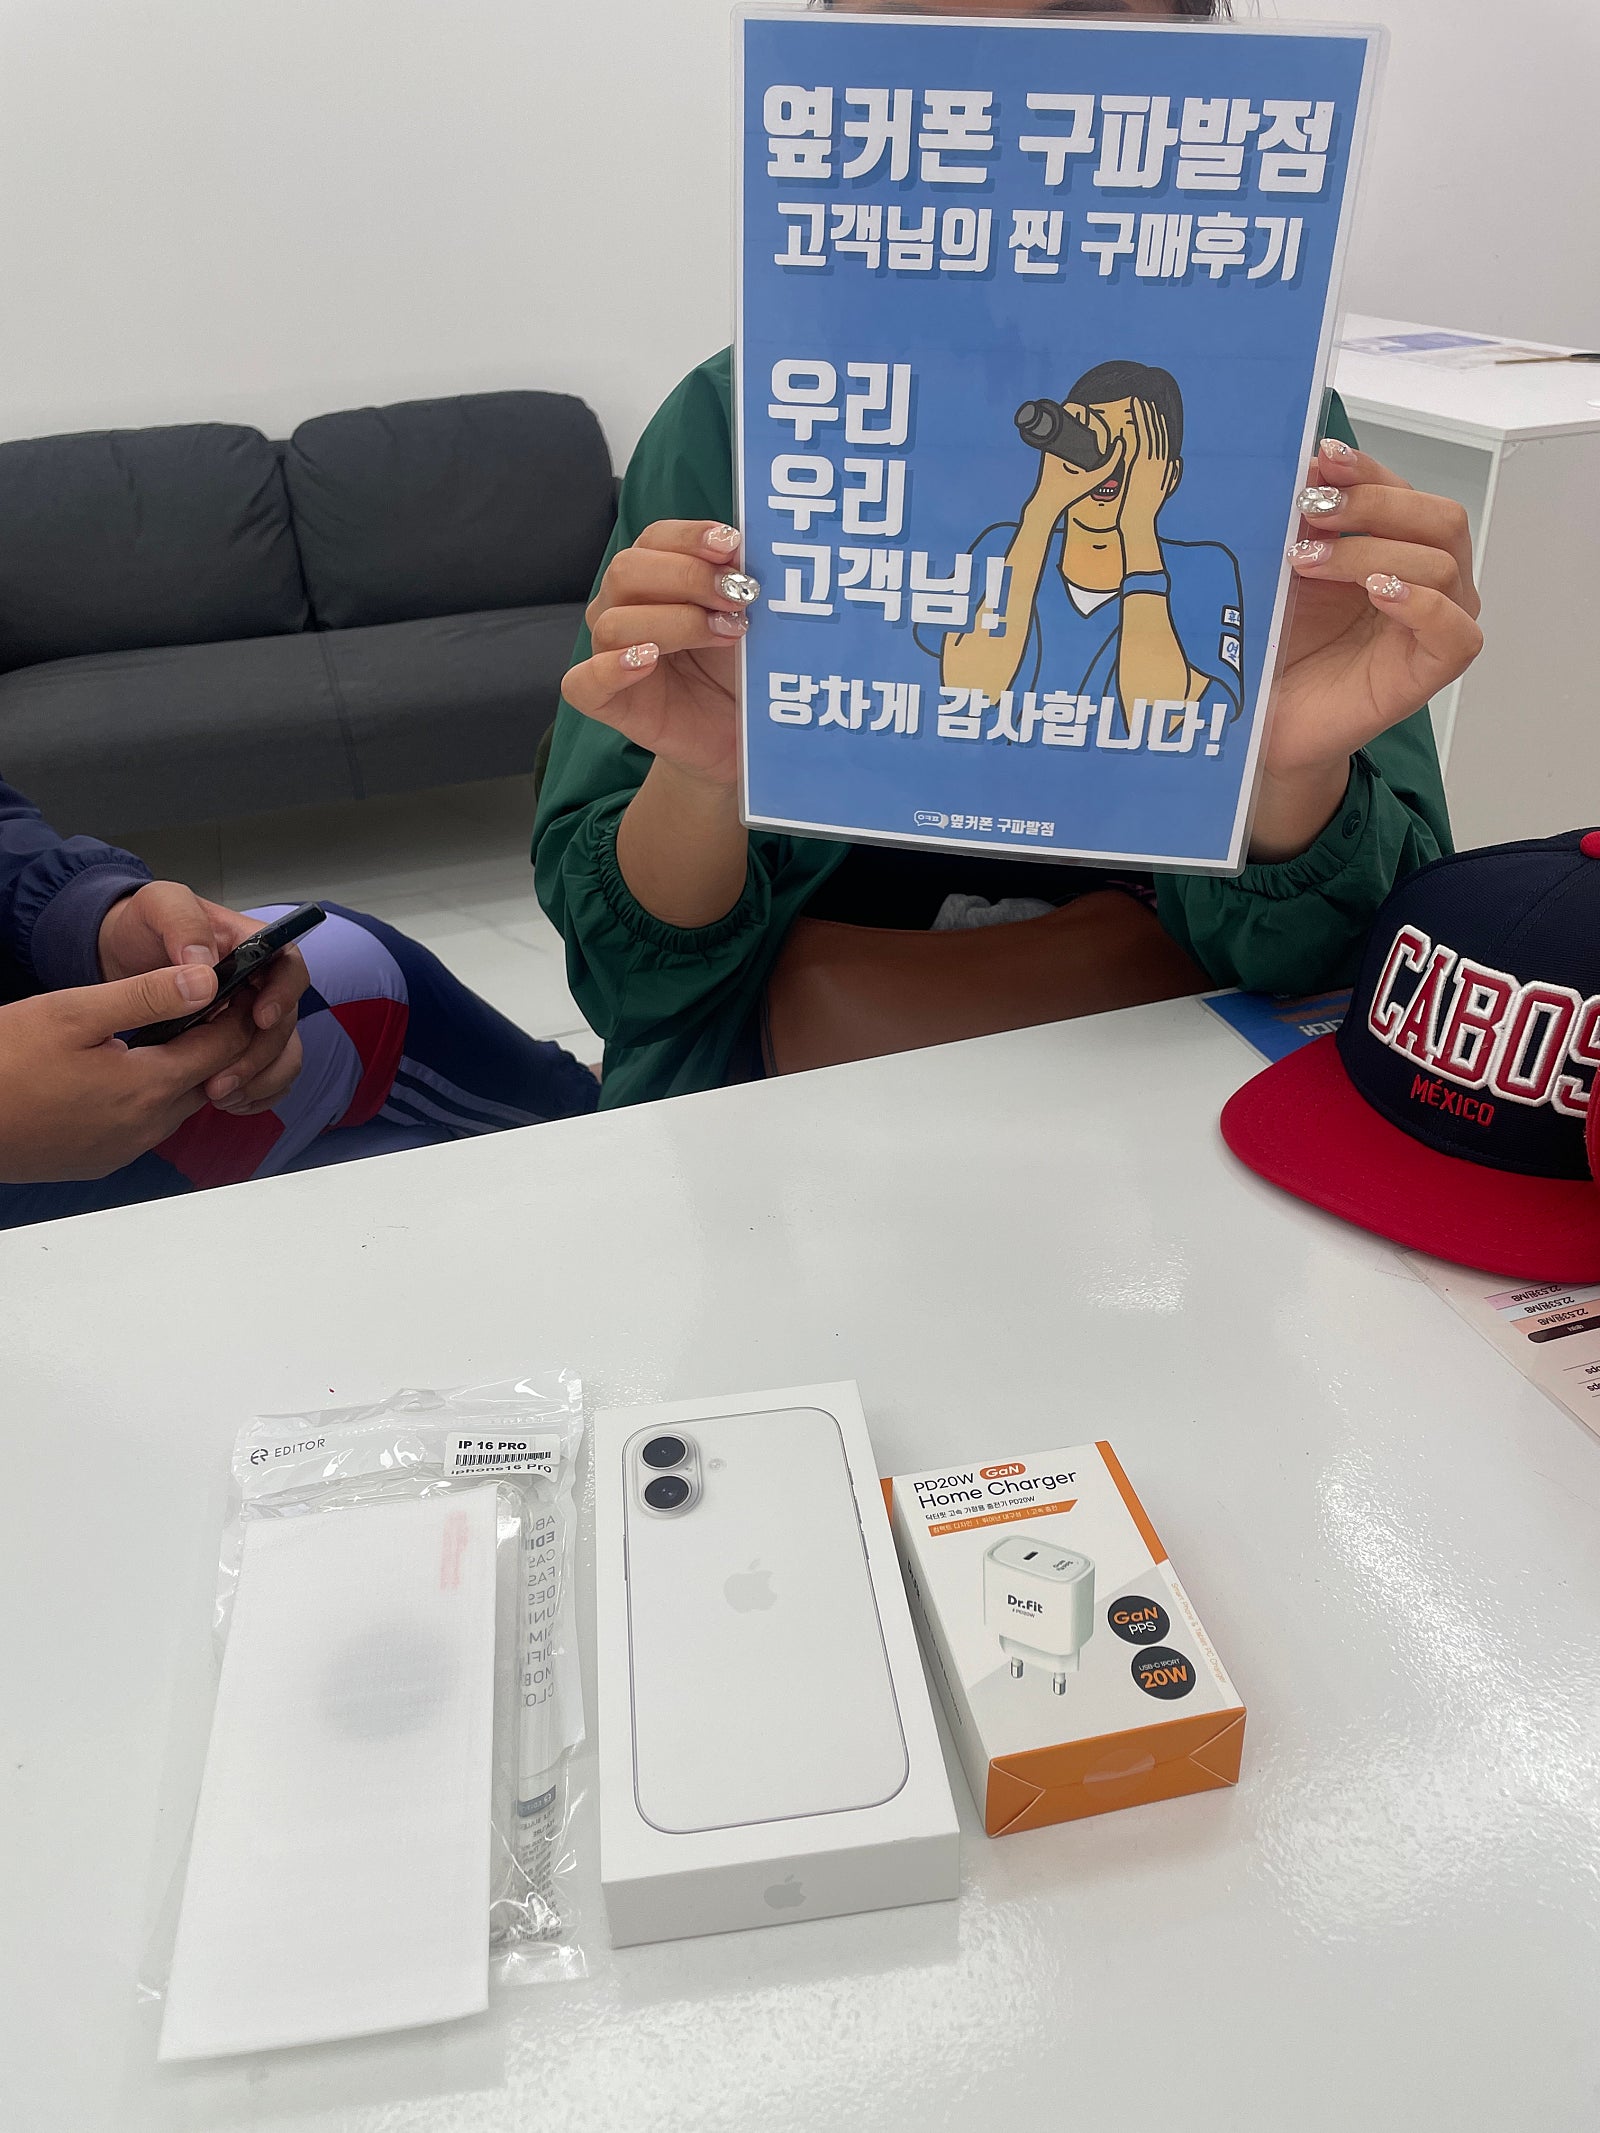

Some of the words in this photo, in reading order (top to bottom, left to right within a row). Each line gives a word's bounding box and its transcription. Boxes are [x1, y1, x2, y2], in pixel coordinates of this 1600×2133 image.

[763, 84, 994, 184] 옆커폰
[1019, 93, 1335, 193] 구파발점
[775, 202, 993, 273] 고객님의
[1008, 209, 1061, 275] 찐
[1081, 211, 1303, 281] 구매후기
[768, 359, 911, 446] 우리
[768, 454, 906, 536] 우리
[768, 542, 1005, 630] 고객님!
[768, 672, 920, 735] 당차게
[937, 685, 1227, 756] 감사합니다!
[951, 814, 993, 831] 옆커폰
[997, 818, 1055, 837] 구파발점
[1410, 1074, 1494, 1127] MÉXICO
[275, 1438, 325, 1457] EDITOR
[458, 1440, 472, 1449] IP
[477, 1441, 494, 1450] 16
[498, 1442, 527, 1450] PRO
[913, 1473, 974, 1493] PD20W
[986, 1465, 1019, 1478] GaN
[918, 1488, 982, 1509] Home
[988, 1472, 1076, 1495] Charger
[1009, 1496, 1035, 1506] PD20W
[1007, 1594, 1043, 1613] Dr.Fit
[1113, 1606, 1158, 1624] GaN
[1129, 1621, 1156, 1635] PPS
[1140, 1665, 1188, 1688] 20W
